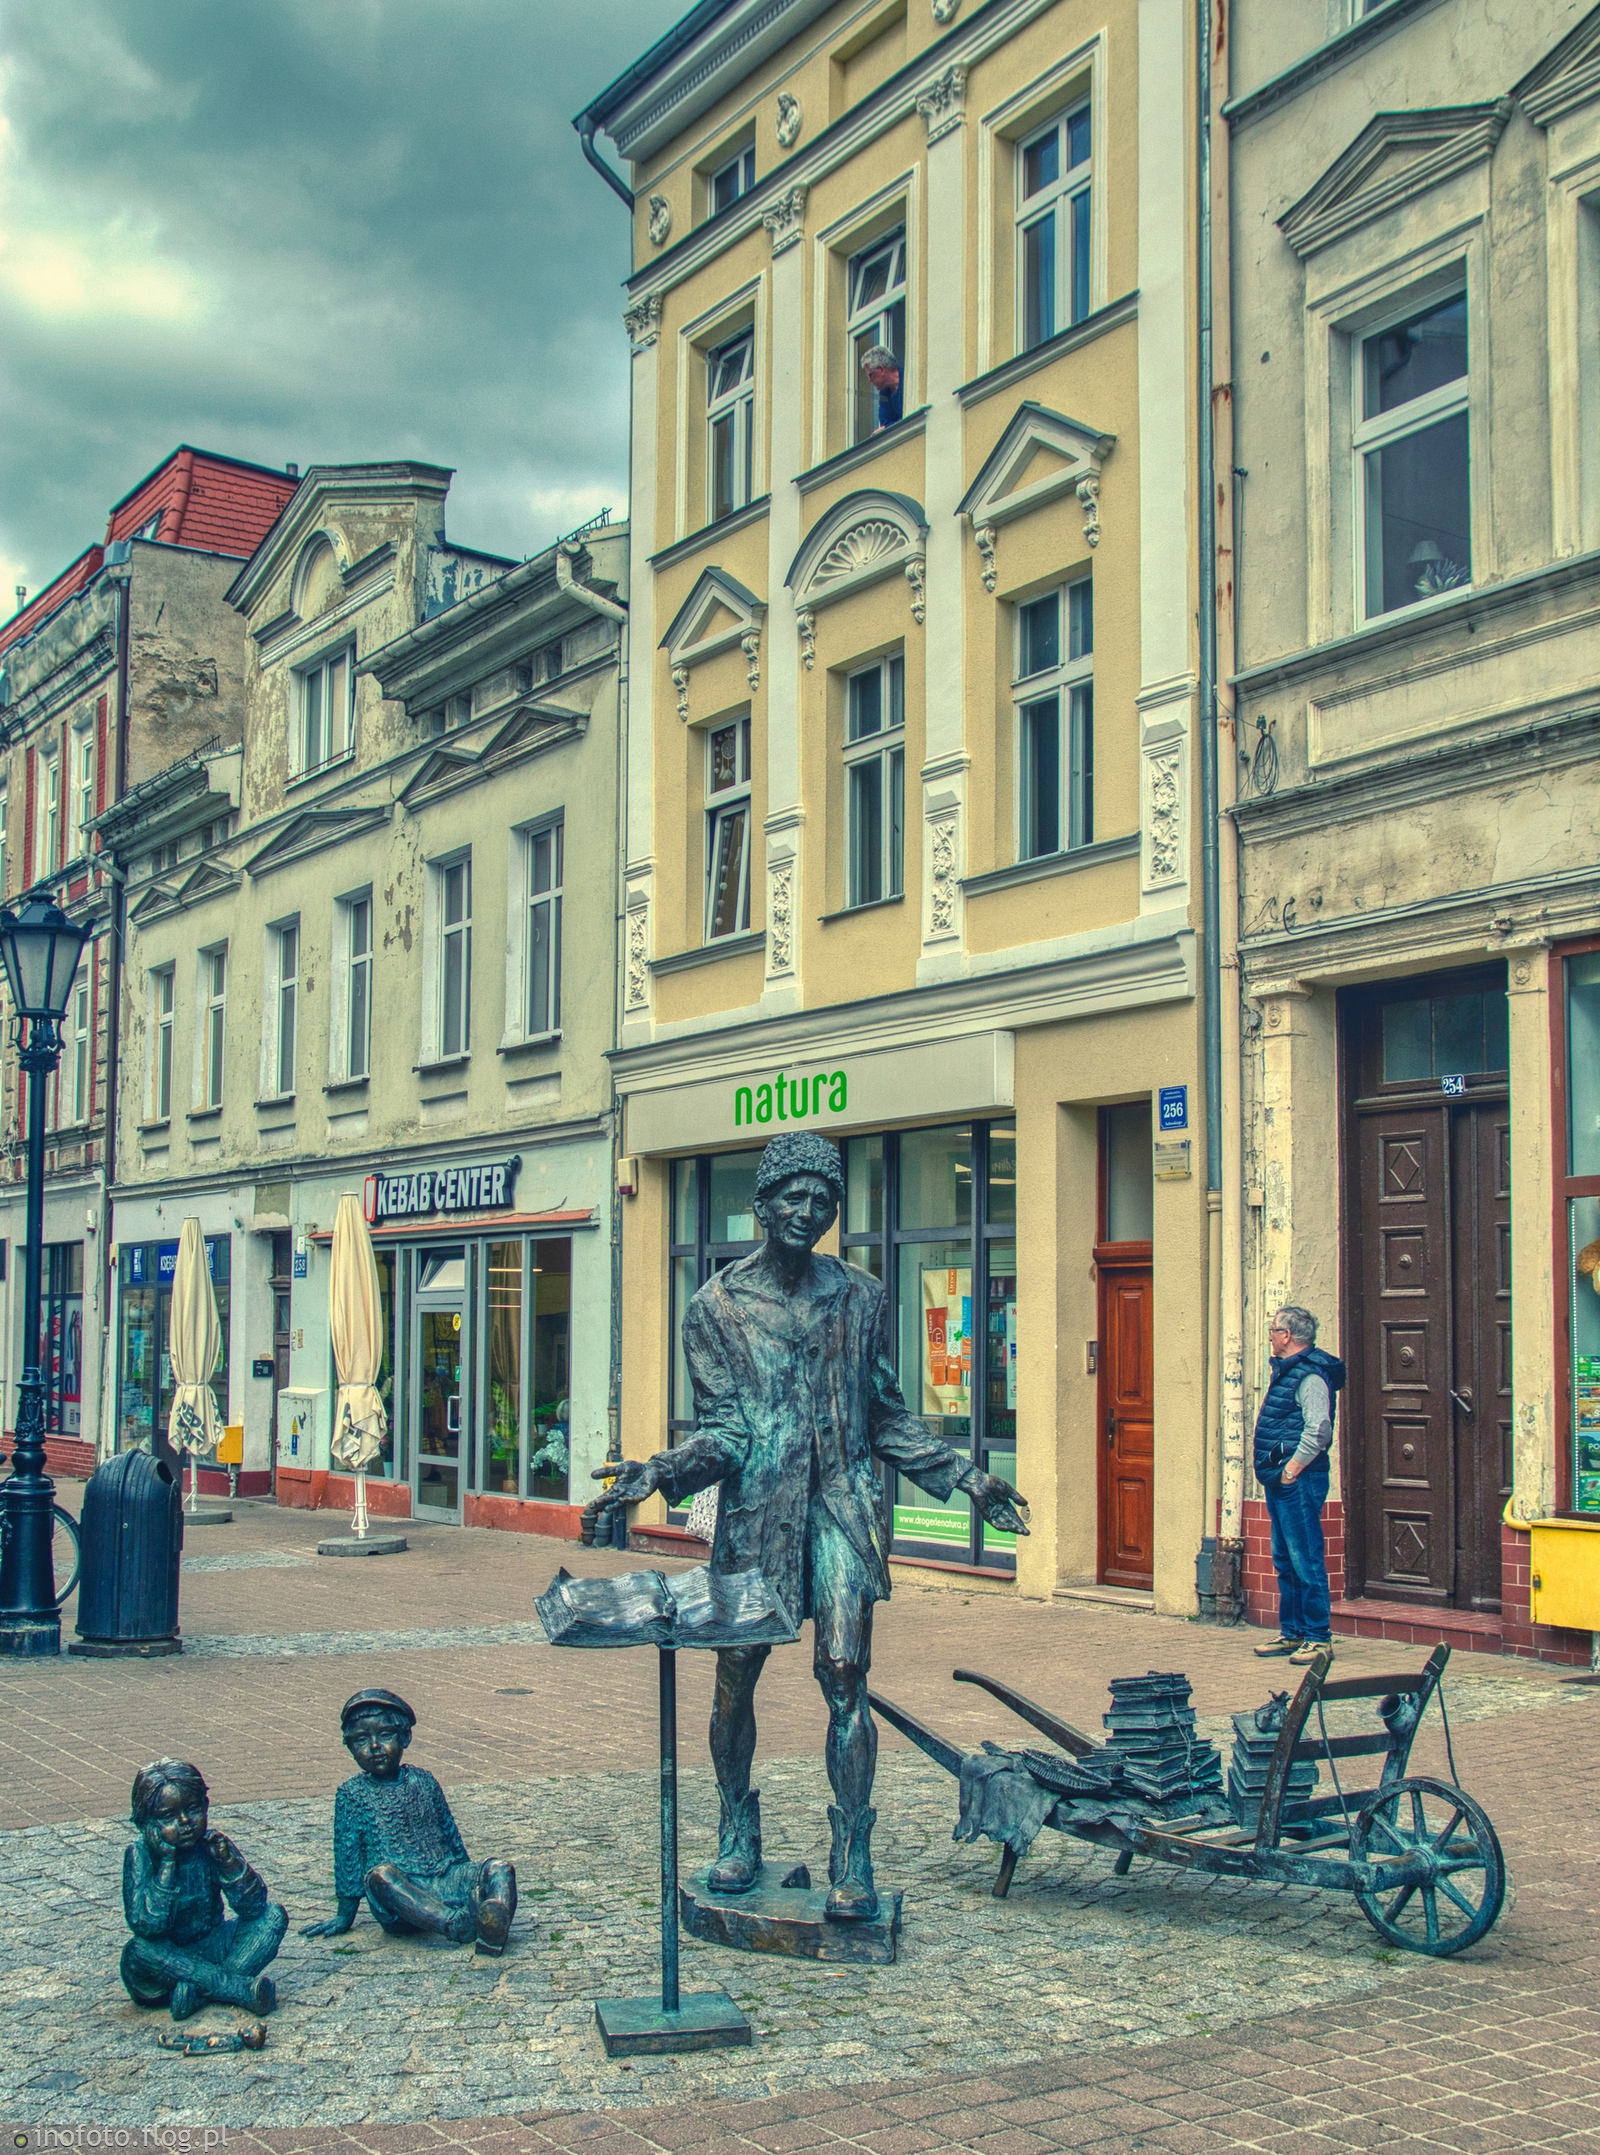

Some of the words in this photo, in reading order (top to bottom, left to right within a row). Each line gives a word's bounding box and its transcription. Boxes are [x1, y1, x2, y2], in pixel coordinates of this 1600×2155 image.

[1442, 1077, 1463, 1094] 254
[735, 1071, 847, 1126] natura
[1163, 1102, 1183, 1118] 256
[376, 1174, 431, 1216] KEBAB
[434, 1165, 506, 1210] CENTER
[294, 1258, 306, 1272] 258
[898, 1515, 969, 1531] www.drogerienatura.pl
